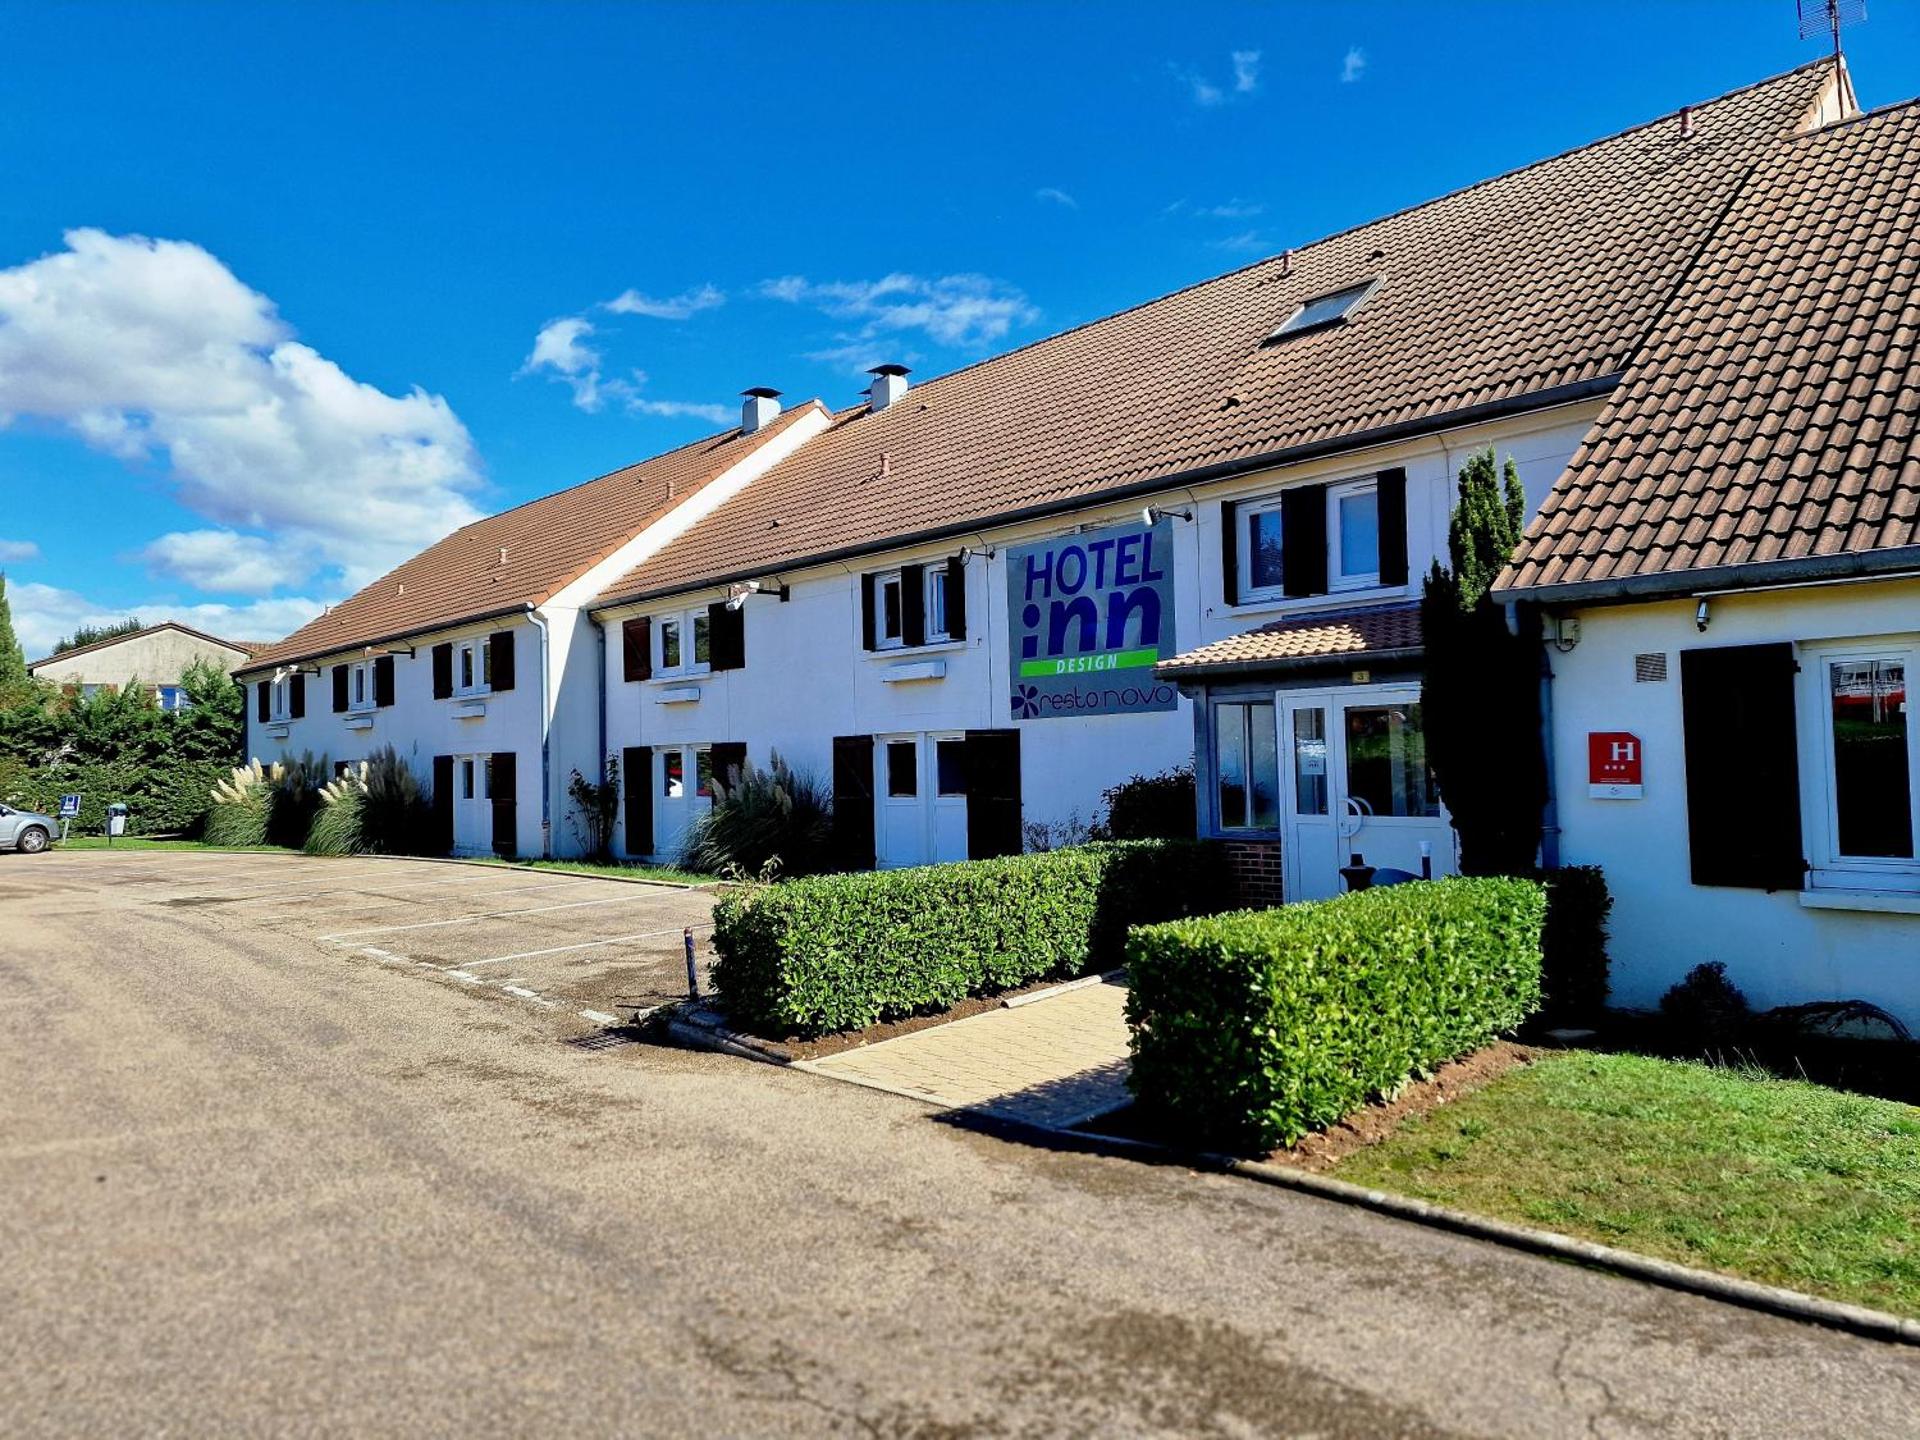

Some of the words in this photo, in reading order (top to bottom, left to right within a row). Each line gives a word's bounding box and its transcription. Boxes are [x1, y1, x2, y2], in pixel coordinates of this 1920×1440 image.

[1024, 531, 1163, 600] HOTEL
[1022, 586, 1161, 658] inn
[1056, 654, 1118, 674] DESIGN
[1039, 684, 1099, 712] resto
[1104, 685, 1174, 708] novo
[1611, 742, 1634, 761] H
